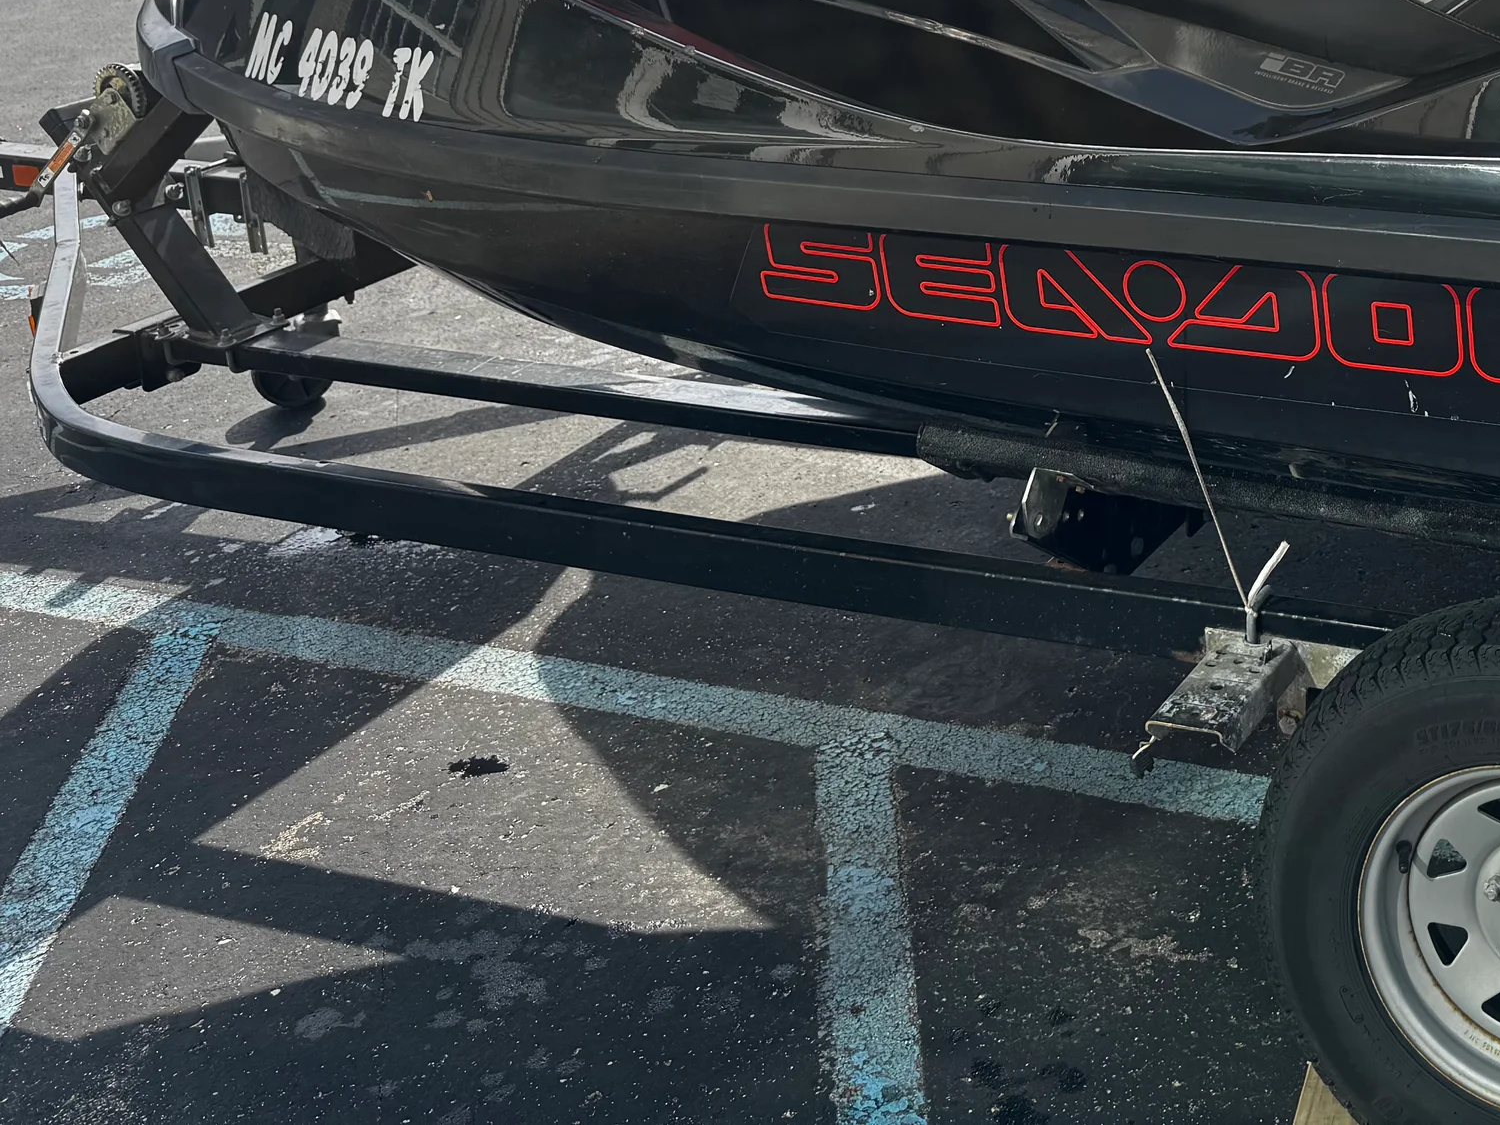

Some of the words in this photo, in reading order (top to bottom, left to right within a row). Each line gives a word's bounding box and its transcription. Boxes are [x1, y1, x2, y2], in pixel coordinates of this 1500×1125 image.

[245, 12, 293, 85] MC
[298, 28, 374, 110] 4039
[382, 47, 434, 122] TK
